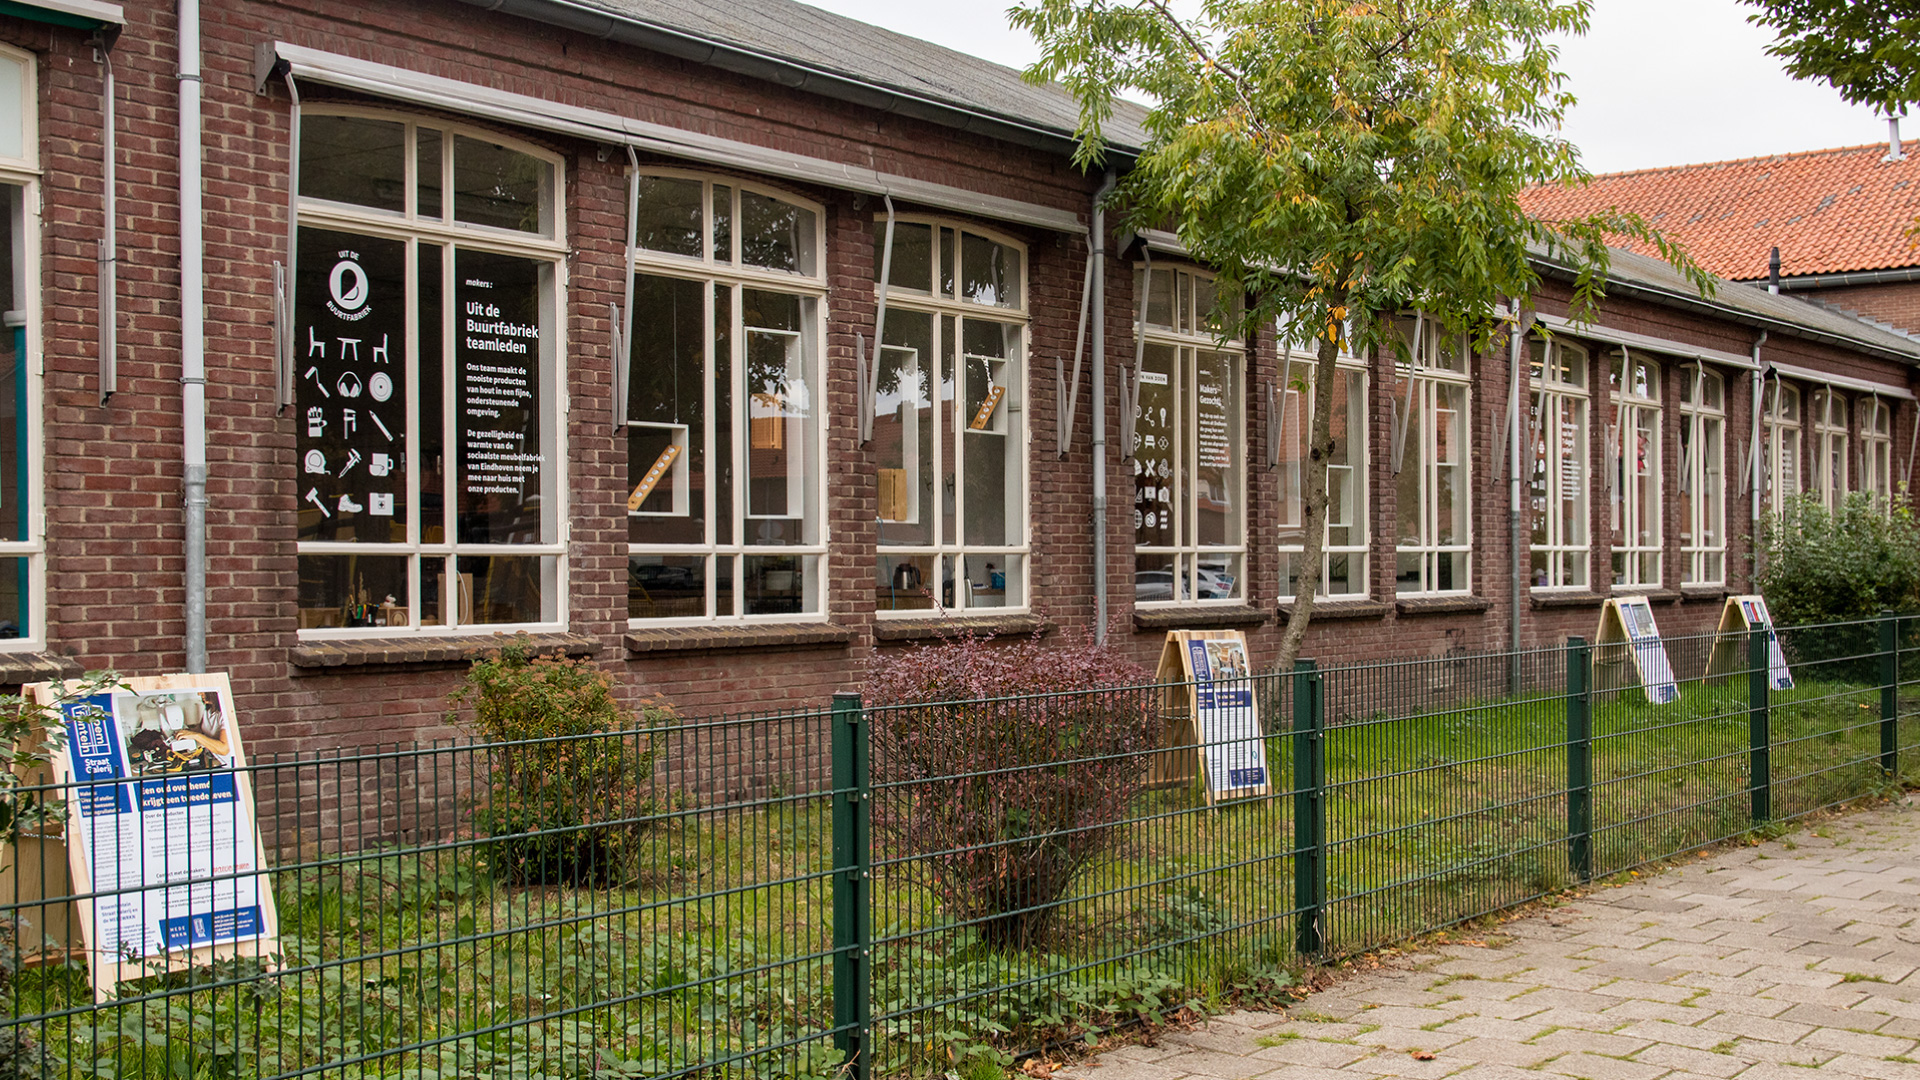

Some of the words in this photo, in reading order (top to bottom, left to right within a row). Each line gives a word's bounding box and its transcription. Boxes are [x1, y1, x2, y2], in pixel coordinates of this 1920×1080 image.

[337, 250, 350, 258] UIT
[350, 251, 360, 260] DE
[326, 300, 372, 321] BUURTFABRIEK
[466, 301, 484, 316] Uit
[485, 304, 500, 317] de
[466, 318, 539, 338] Buurtfabriek
[466, 336, 527, 354] teamleden
[466, 363, 479, 371] Ons
[480, 364, 496, 372] team
[497, 366, 518, 374] maakt
[518, 367, 527, 375] de
[466, 375, 492, 383] mooiste
[493, 377, 527, 386] producten
[480, 386, 495, 394] hout
[495, 387, 502, 395] in
[515, 388, 532, 398] fijne,
[466, 396, 519, 407] ondersteunende
[466, 408, 500, 418] omgeving.
[467, 429, 476, 437] De
[476, 430, 515, 440] gezelligheid
[506, 442, 514, 450] de
[467, 451, 499, 460] sociaalste
[500, 452, 545, 462] meubelfabriek
[480, 462, 514, 471] Eindhoven
[532, 464, 538, 474] je
[498, 474, 512, 482] huis
[512, 475, 525, 483] met
[484, 485, 519, 494] producten.
[75, 710, 92, 753] fntein
[84, 757, 110, 767] Straat
[142, 797, 164, 807] krijgt
